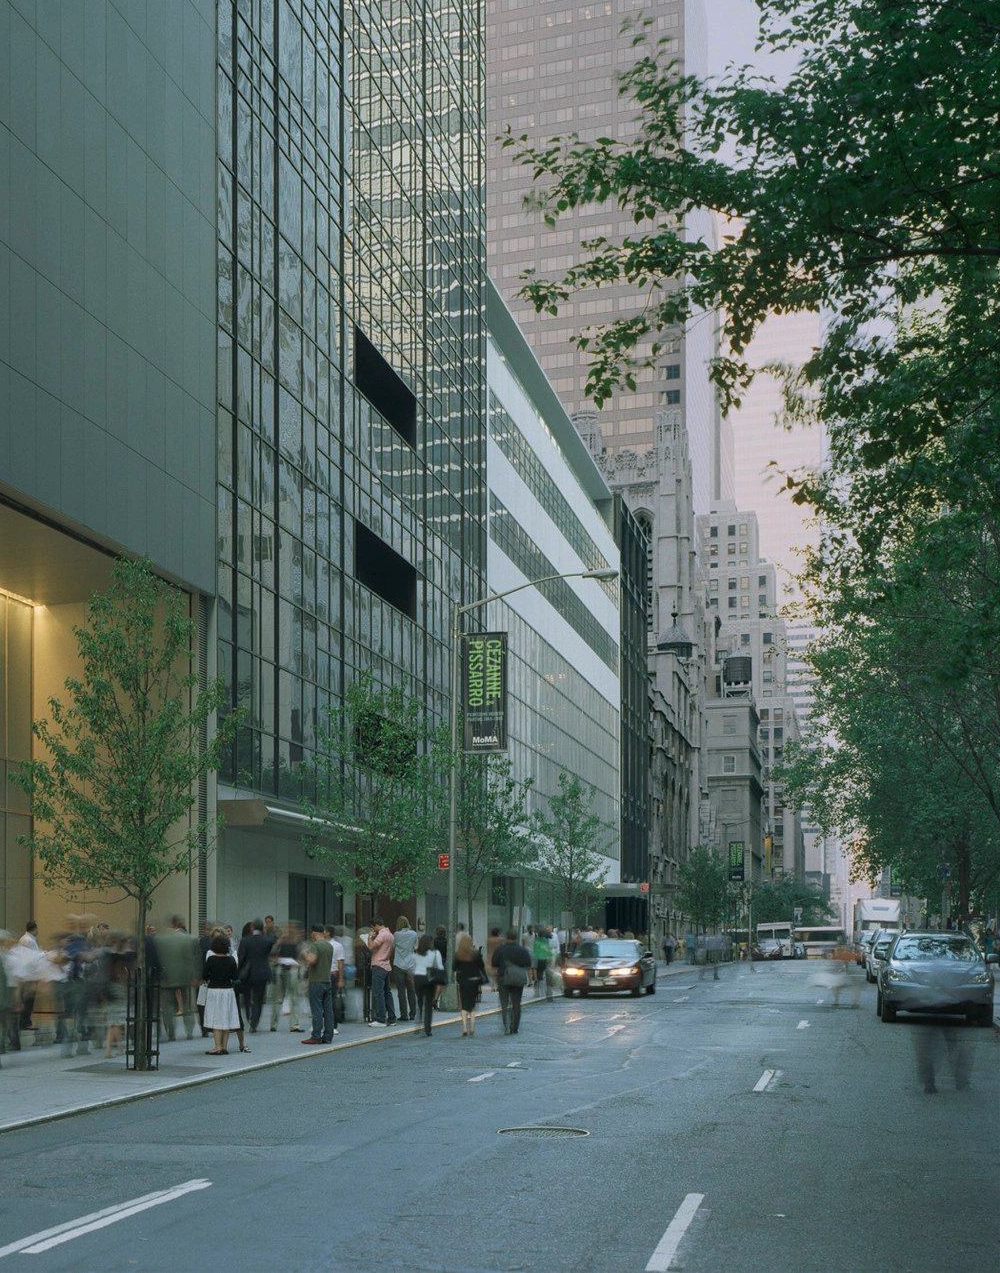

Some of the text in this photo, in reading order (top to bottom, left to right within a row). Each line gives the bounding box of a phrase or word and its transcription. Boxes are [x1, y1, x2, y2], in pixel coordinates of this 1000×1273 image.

[468, 640, 484, 707] PISSARRO
[486, 639, 506, 699] CÉZANNE
[472, 736, 498, 744] MoMA
